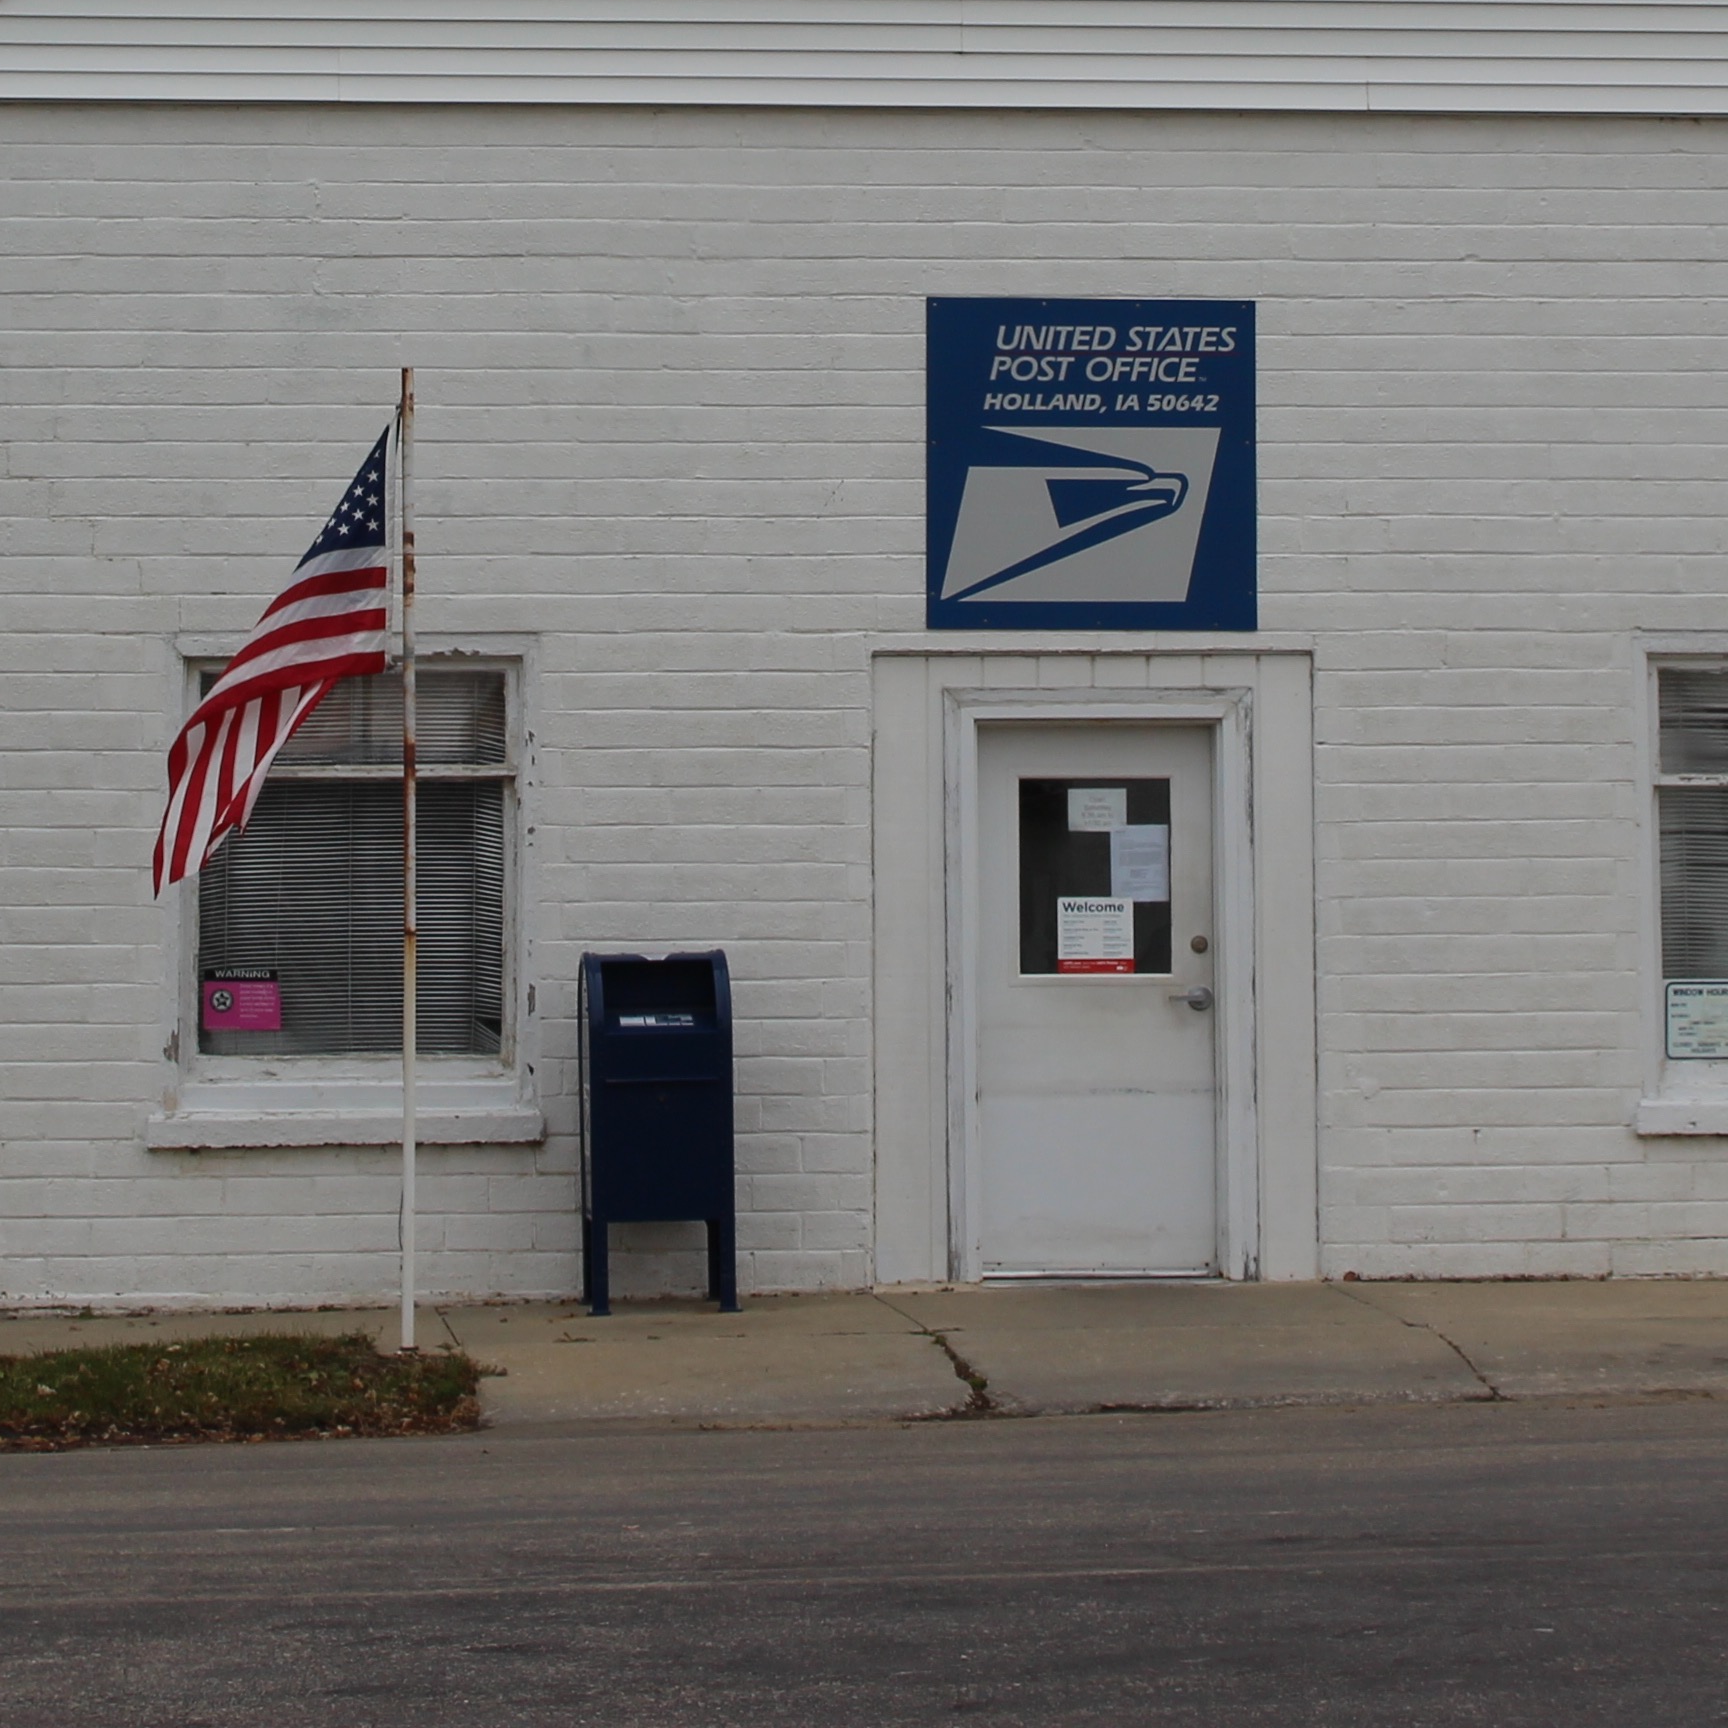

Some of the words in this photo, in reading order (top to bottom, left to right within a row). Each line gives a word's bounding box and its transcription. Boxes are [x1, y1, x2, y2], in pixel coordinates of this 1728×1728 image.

[996, 325, 1117, 351] UNITED
[1125, 326, 1237, 352] STATES
[989, 356, 1075, 381] POST
[1085, 357, 1200, 382] OFFICE
[983, 393, 1108, 413] HOLLAND,
[1115, 394, 1140, 411] IA
[1147, 394, 1220, 412] 50642
[1062, 901, 1125, 913] Welcome
[215, 969, 270, 978] WARNING
[1673, 988, 1704, 997] WINDOW
